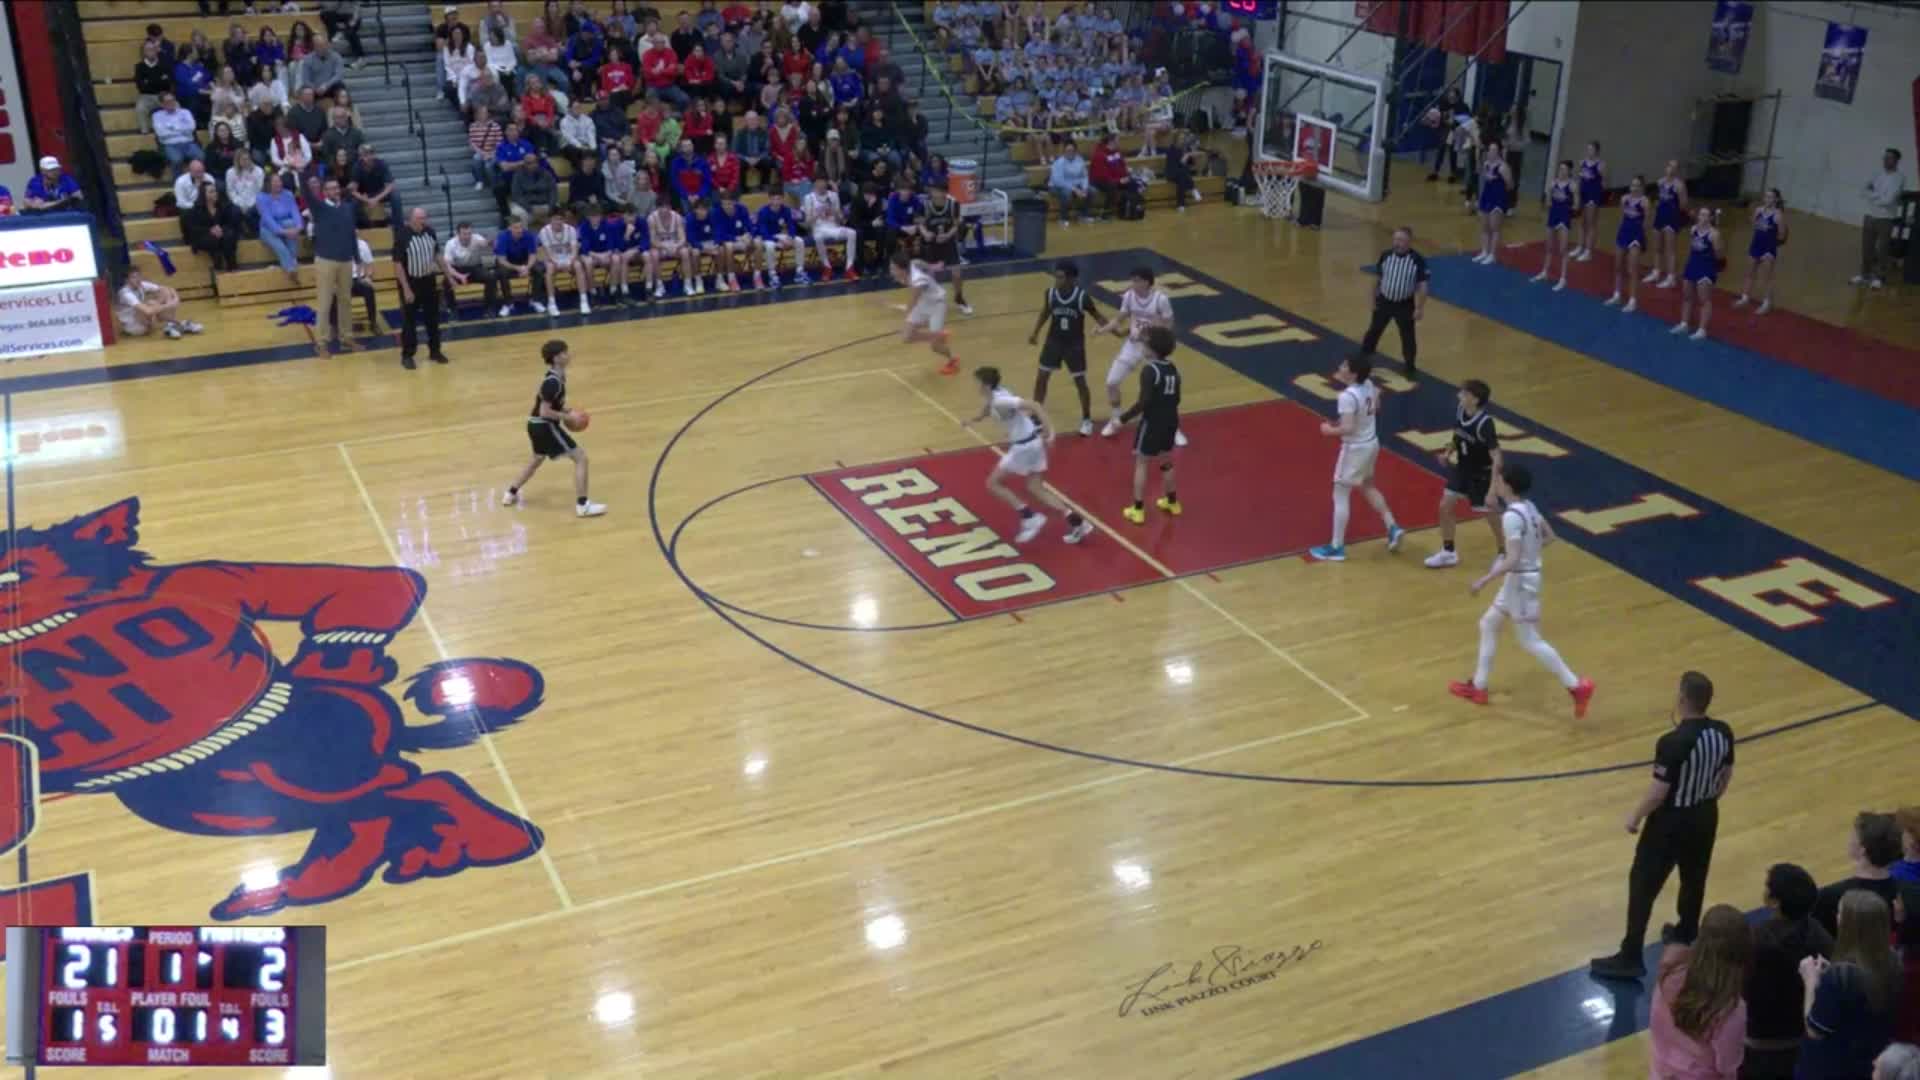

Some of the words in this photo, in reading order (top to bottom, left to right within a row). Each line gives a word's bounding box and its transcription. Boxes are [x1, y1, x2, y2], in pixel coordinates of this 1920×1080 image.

[58, 290, 86, 305] LLC
[1163, 375, 1177, 395] 11
[840, 466, 1057, 602] RENO
[0, 607, 214, 702] NO
